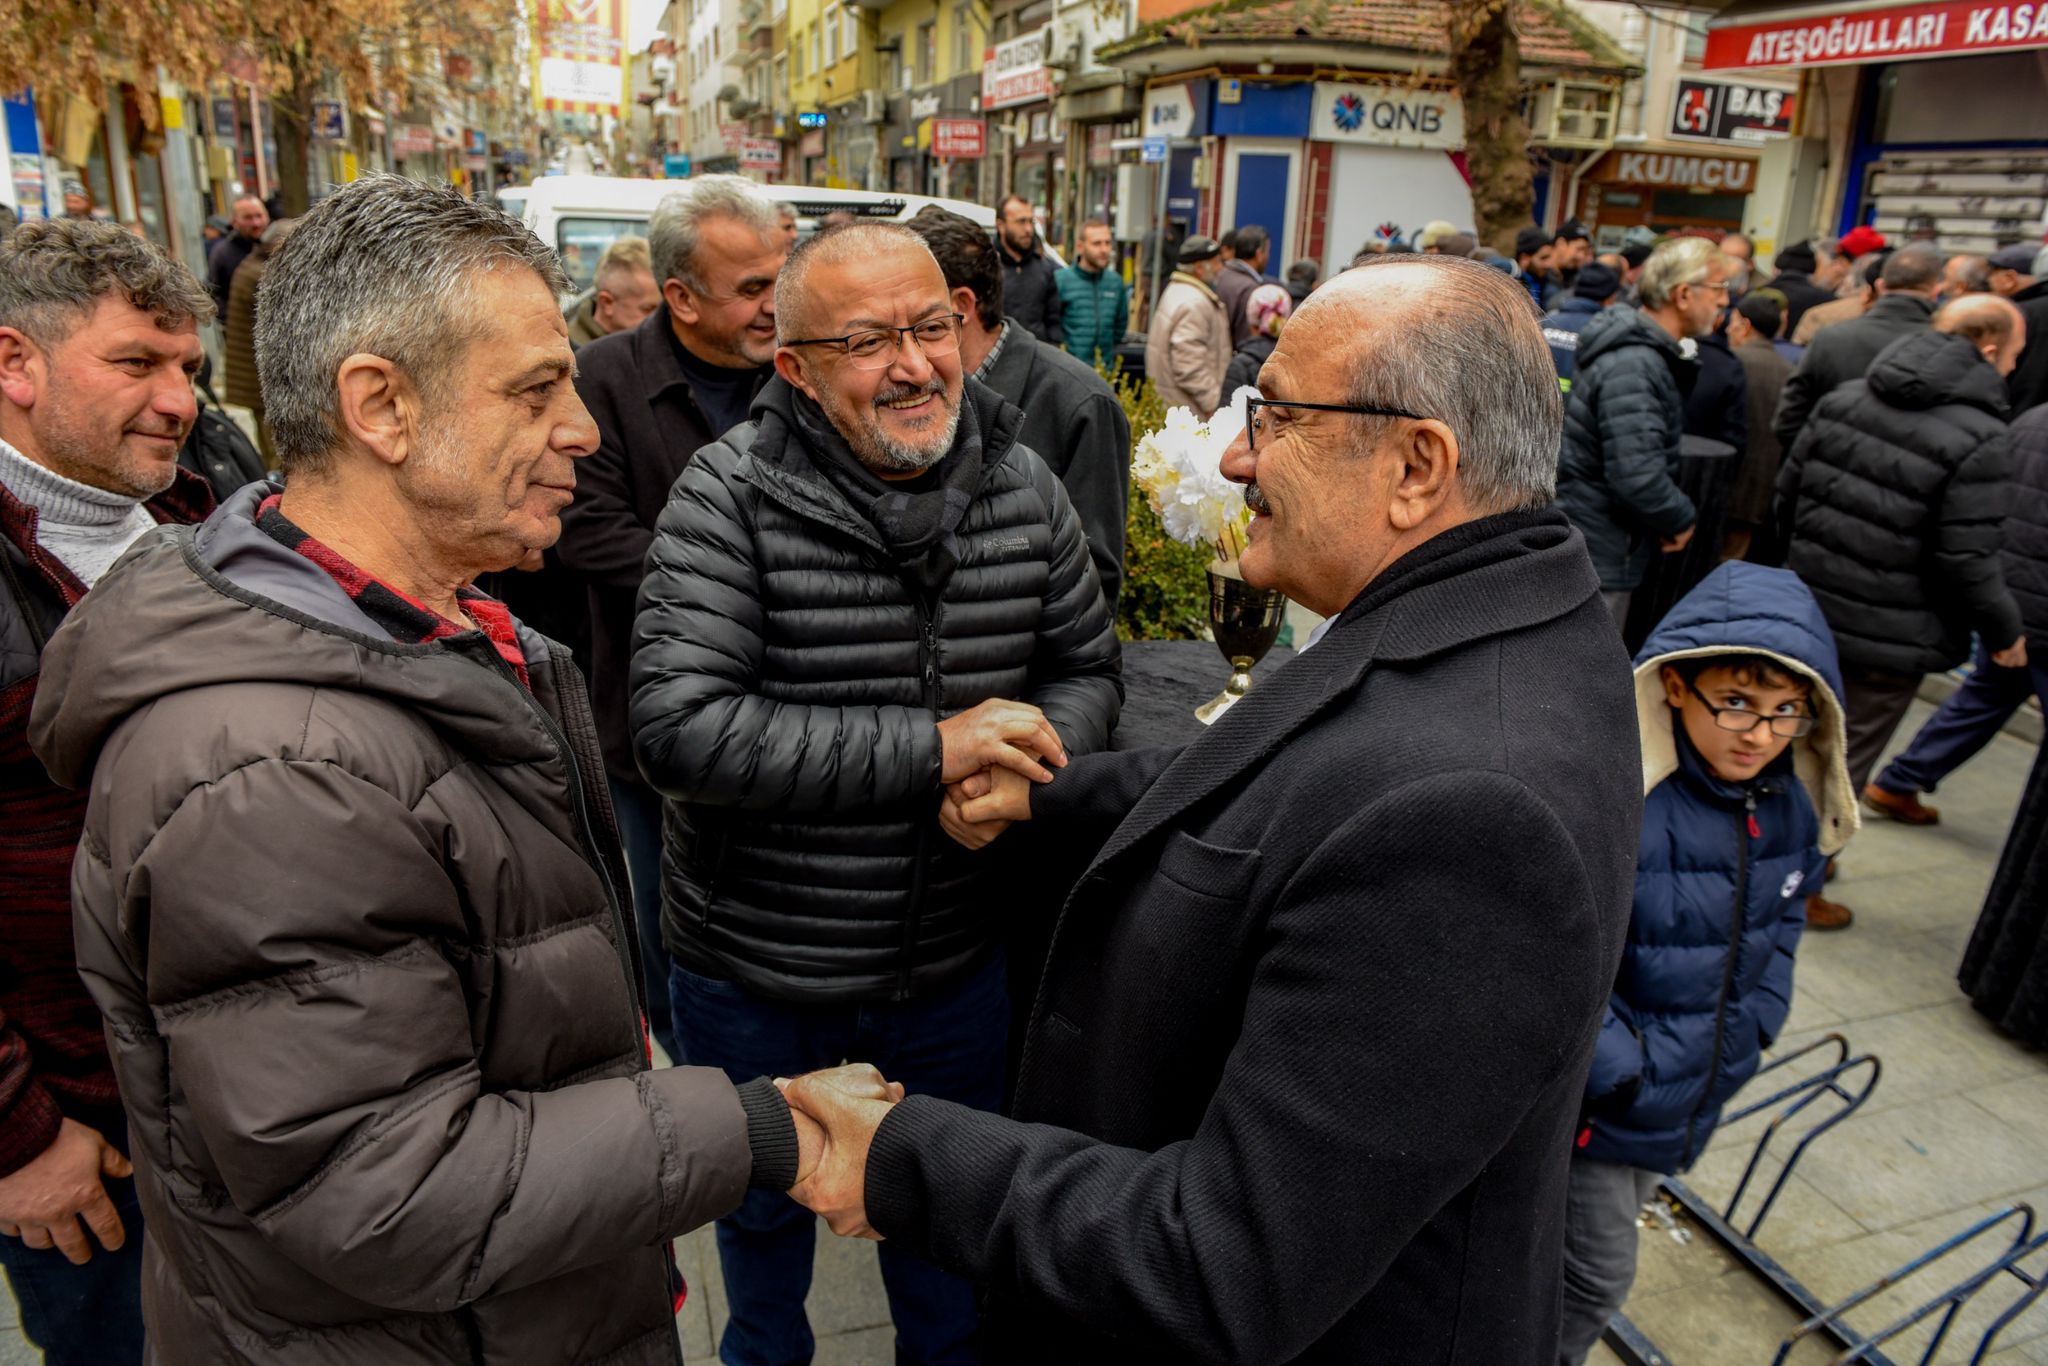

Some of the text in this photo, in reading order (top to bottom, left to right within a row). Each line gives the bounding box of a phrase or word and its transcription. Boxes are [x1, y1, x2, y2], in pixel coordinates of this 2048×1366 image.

[1745, 12, 1948, 63] ATEŞOĞULLARI
[1372, 101, 1442, 133] QNB
[1617, 152, 1750, 189] KUMCU
[993, 535, 1029, 547] Columbia
